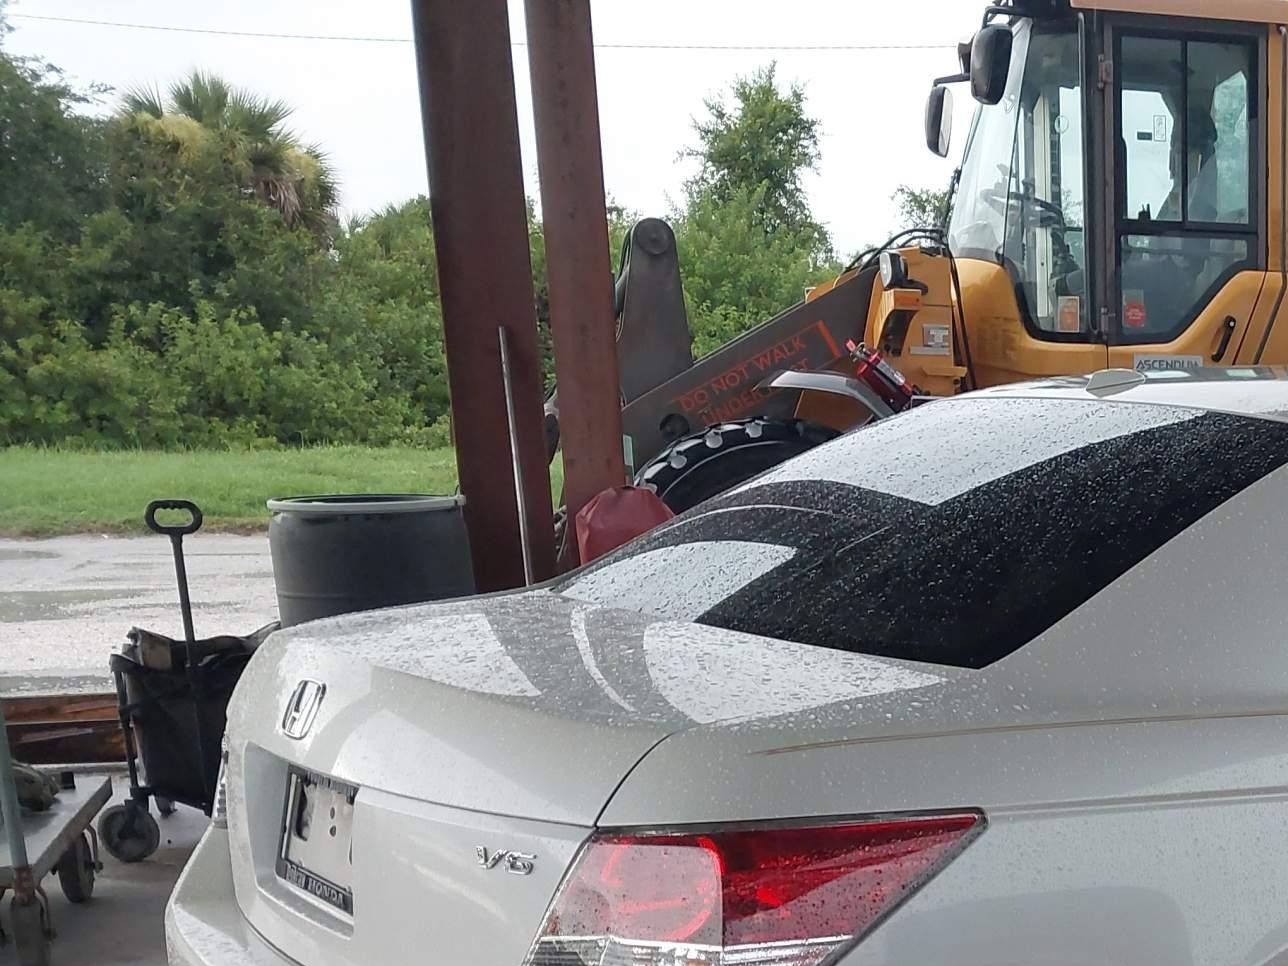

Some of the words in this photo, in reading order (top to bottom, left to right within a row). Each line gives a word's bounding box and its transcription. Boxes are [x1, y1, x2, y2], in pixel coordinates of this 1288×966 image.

[679, 389, 709, 412] DO
[711, 365, 751, 395] NOT
[752, 335, 807, 372] WALK
[475, 845, 537, 875] V6
[307, 876, 345, 906] HONDA
